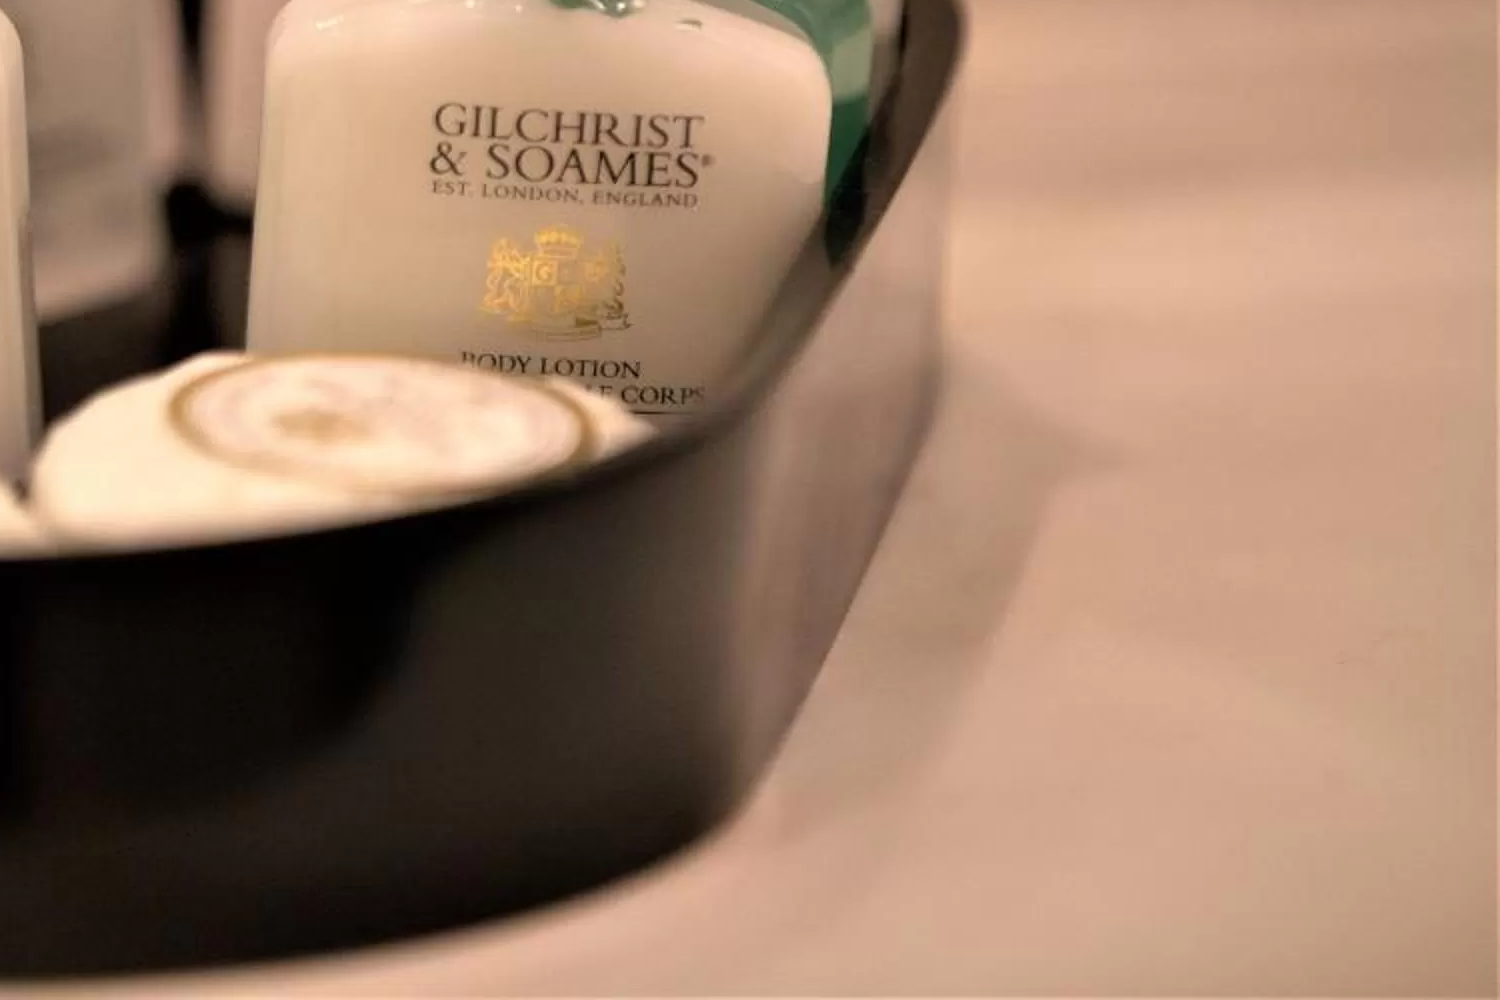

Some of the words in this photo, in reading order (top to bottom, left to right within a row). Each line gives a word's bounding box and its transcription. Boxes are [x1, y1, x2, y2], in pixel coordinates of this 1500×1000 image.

[434, 102, 705, 150] GILCHRIST
[429, 140, 467, 177] &
[592, 190, 699, 209] ENGLAND
[539, 357, 642, 380] LOTION
